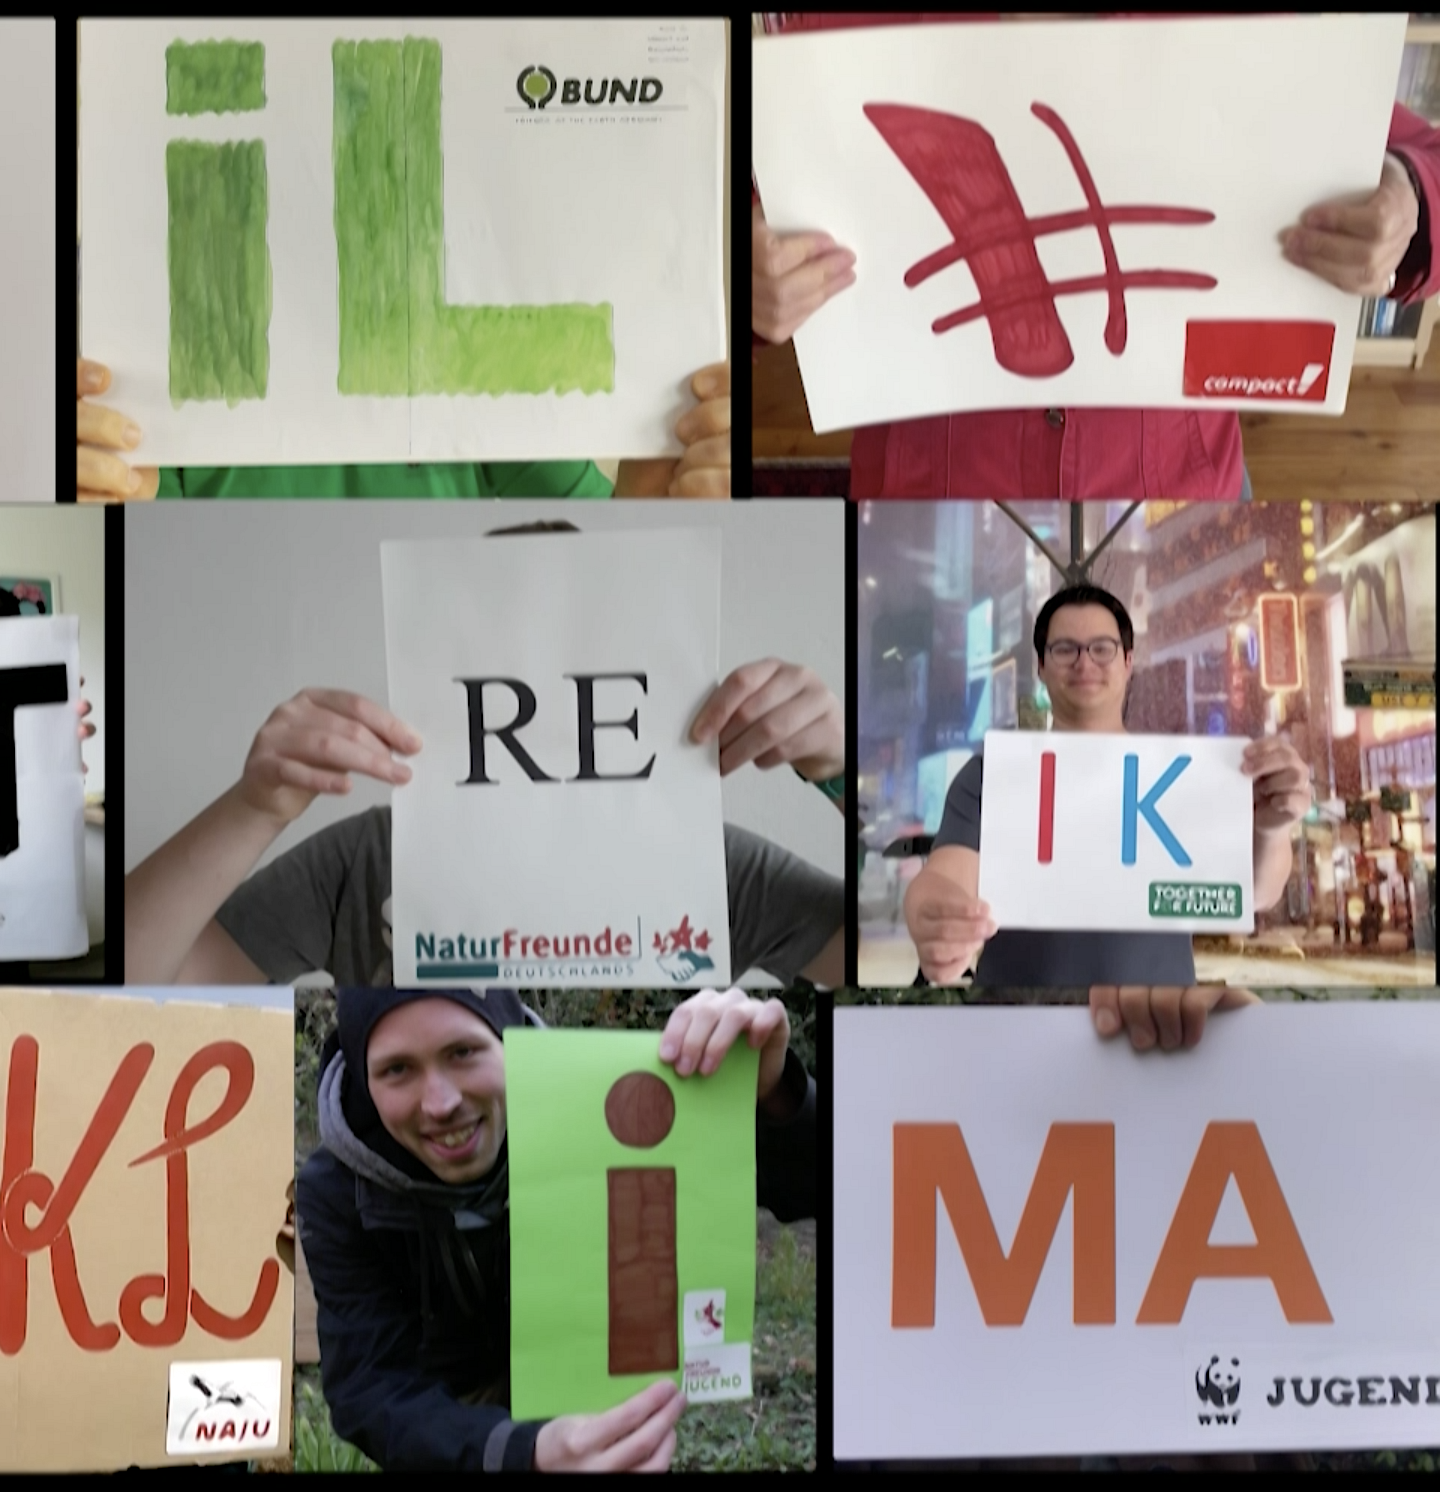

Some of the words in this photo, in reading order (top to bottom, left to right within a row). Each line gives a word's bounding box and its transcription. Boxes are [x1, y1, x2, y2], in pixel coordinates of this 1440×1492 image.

[560, 77, 664, 105] BUND
[452, 671, 657, 787] RE
[1154, 886, 1236, 900] TOGETHER
[1186, 900, 1236, 915] FUTURE
[504, 965, 635, 979] DEUTSCHLANDS
[891, 1120, 1335, 1329] MA
[1197, 1411, 1241, 1426] WWF
